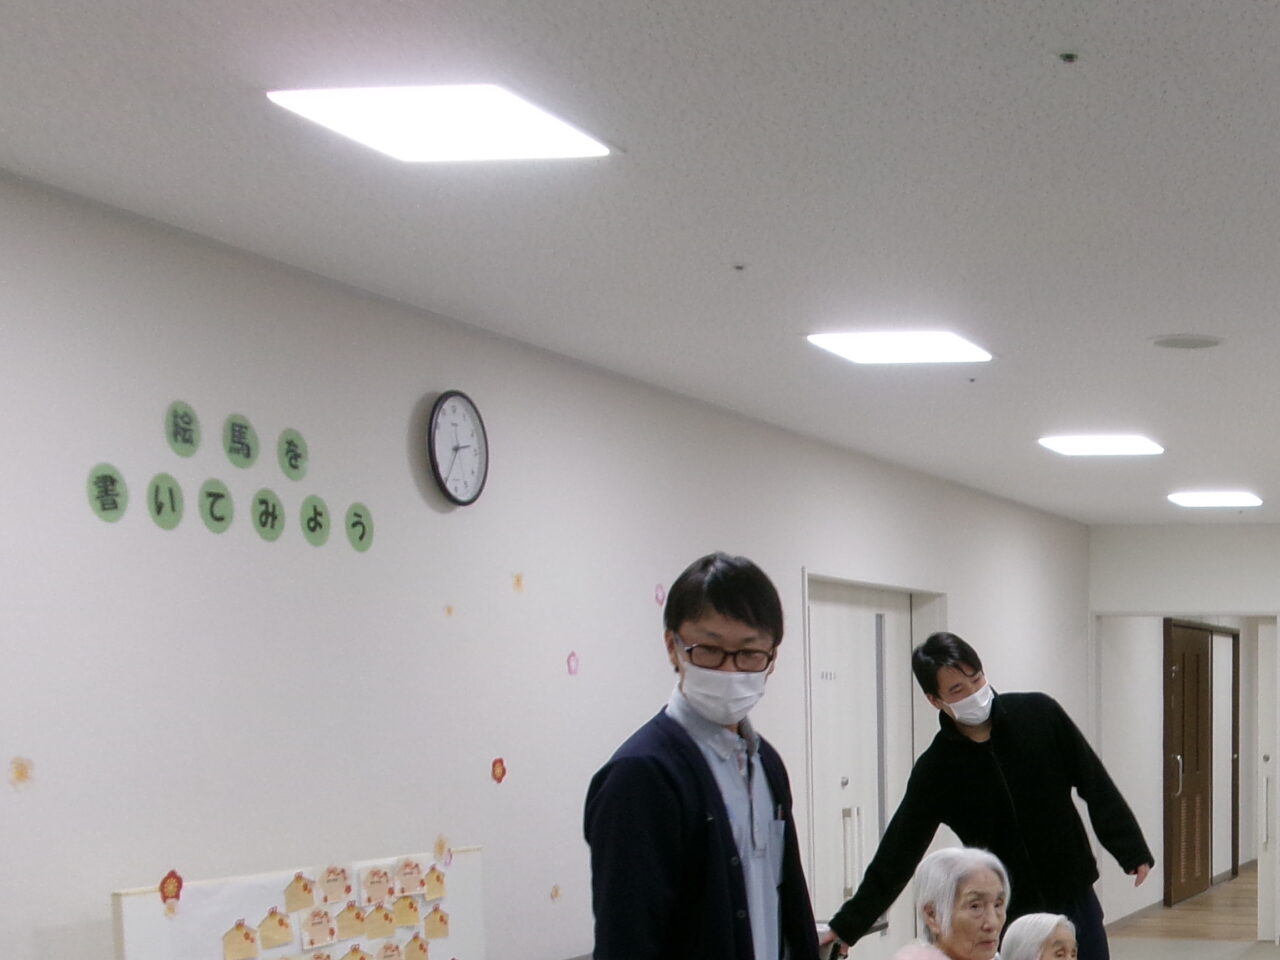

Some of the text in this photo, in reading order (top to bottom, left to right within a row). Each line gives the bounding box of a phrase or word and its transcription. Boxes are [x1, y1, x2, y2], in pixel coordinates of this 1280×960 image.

[172, 409, 303, 470] 絵馬を
[93, 474, 366, 542] 書いてみよう
